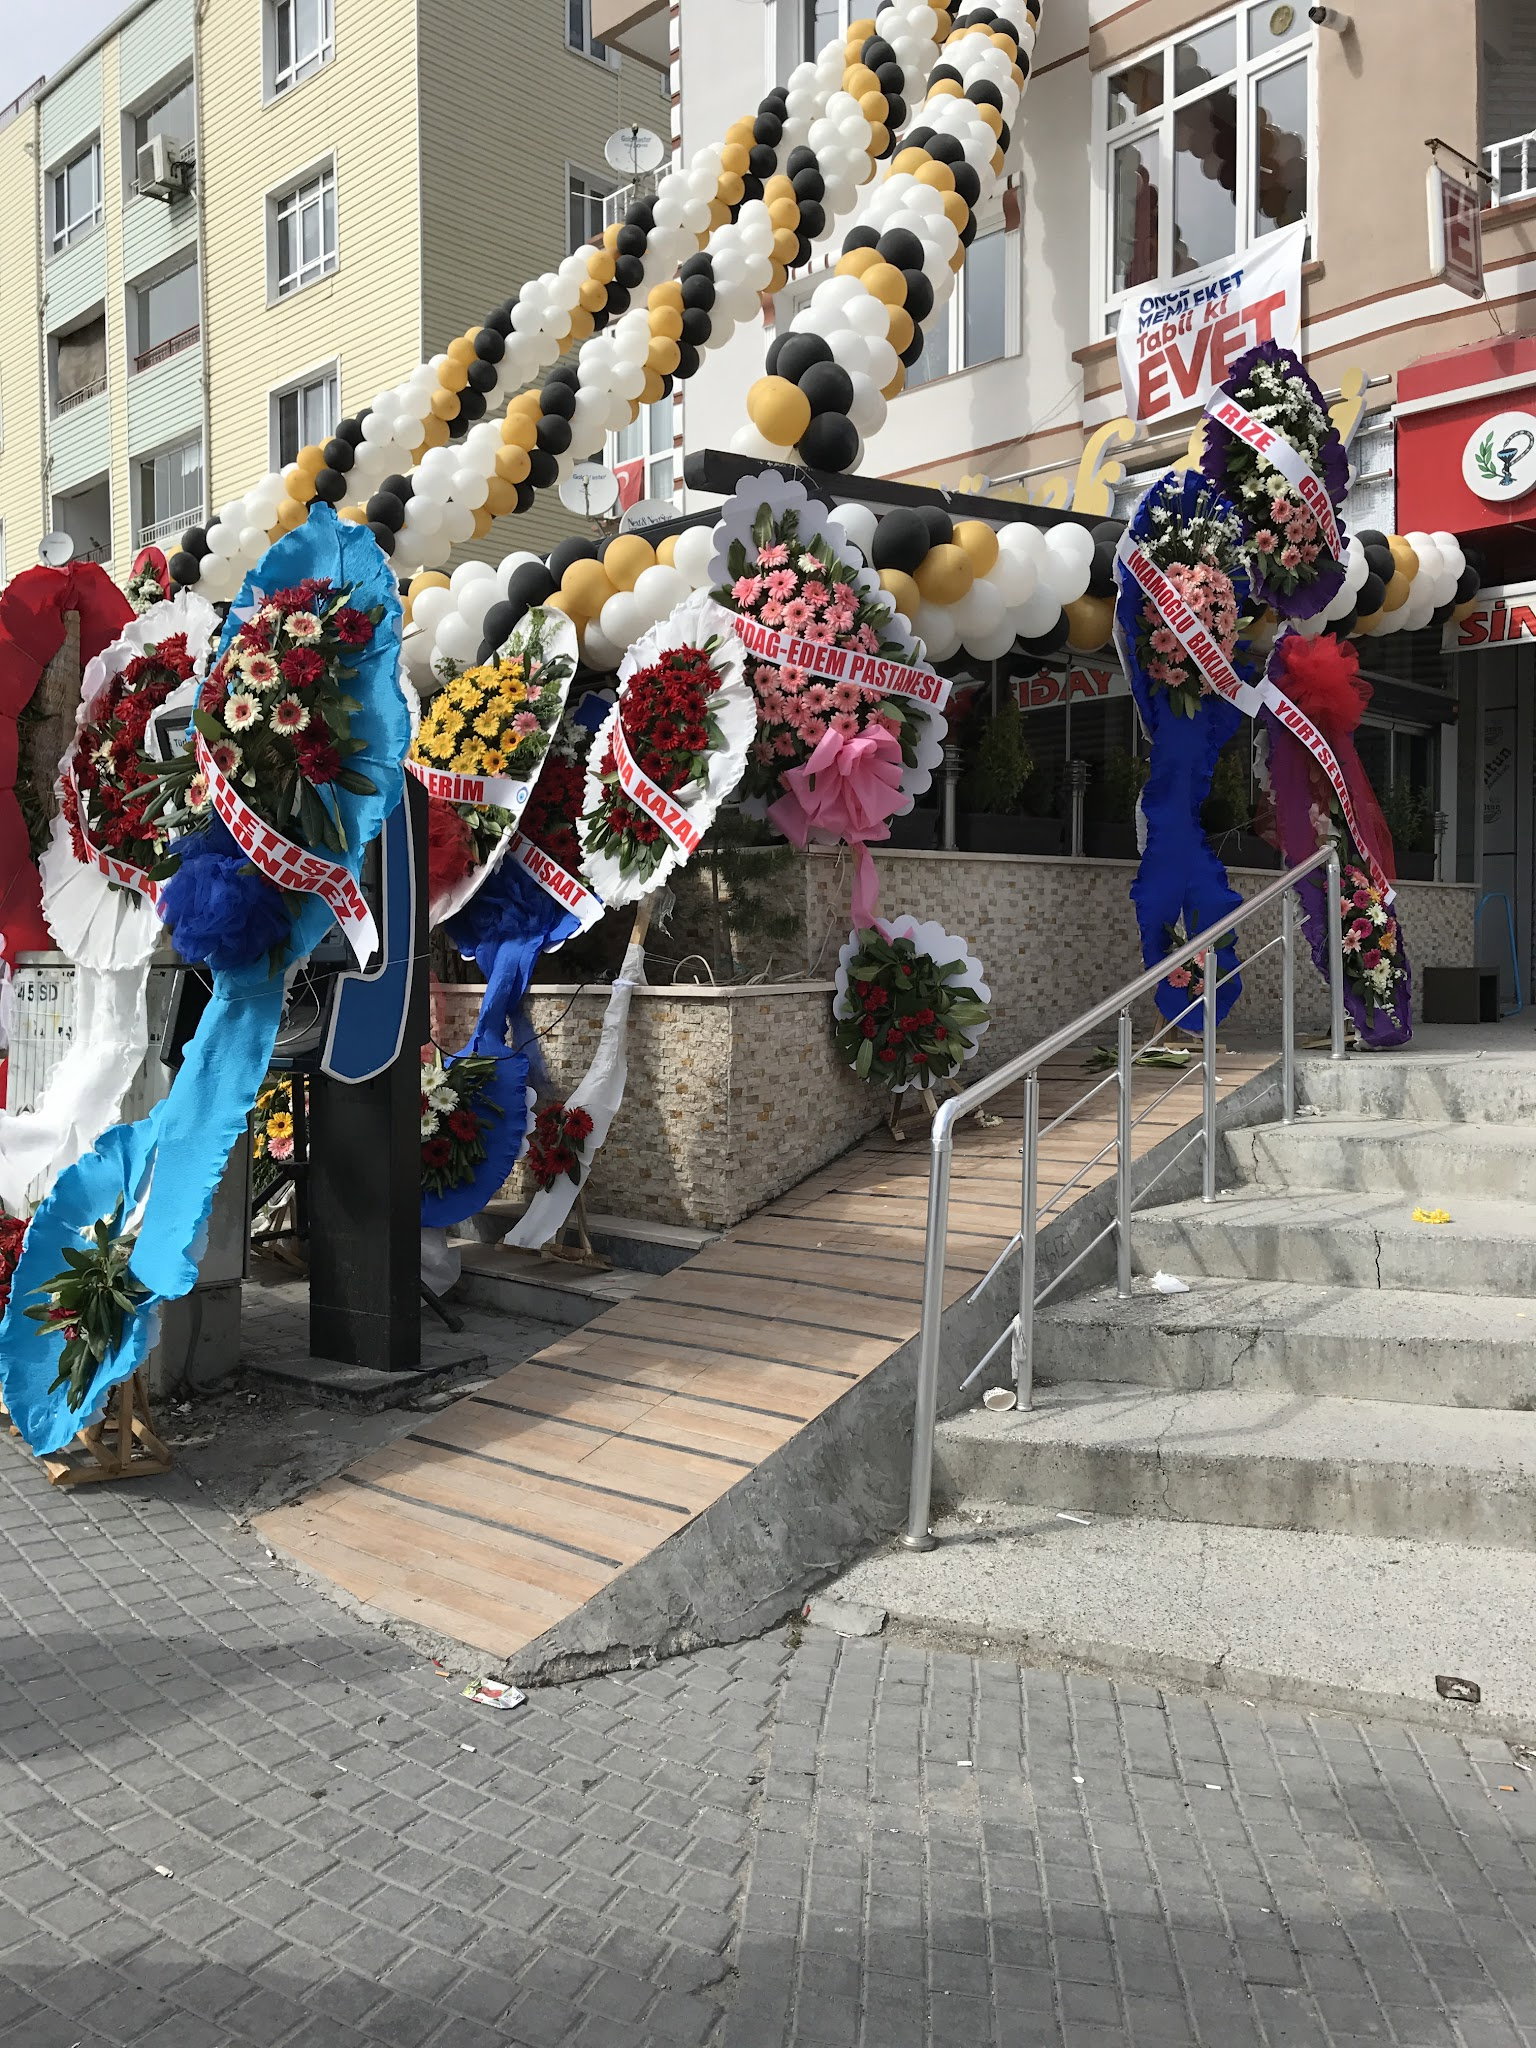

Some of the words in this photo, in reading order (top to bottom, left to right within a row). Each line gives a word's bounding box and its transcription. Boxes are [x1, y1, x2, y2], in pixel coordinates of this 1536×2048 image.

[1136, 309, 1194, 359] Tabii
[1138, 269, 1244, 334] MEMLEKET
[1137, 289, 1286, 421] EVET
[1298, 475, 1343, 561] GROSS
[1127, 549, 1196, 634] İMAMOĞLU
[848, 653, 944, 704] PASTANESİ
[214, 793, 352, 926] DÖNMEZ
[215, 773, 368, 922] İLETİŞİM
[522, 845, 587, 908] İNŞAAT
[39, 984, 58, 1002] SD
